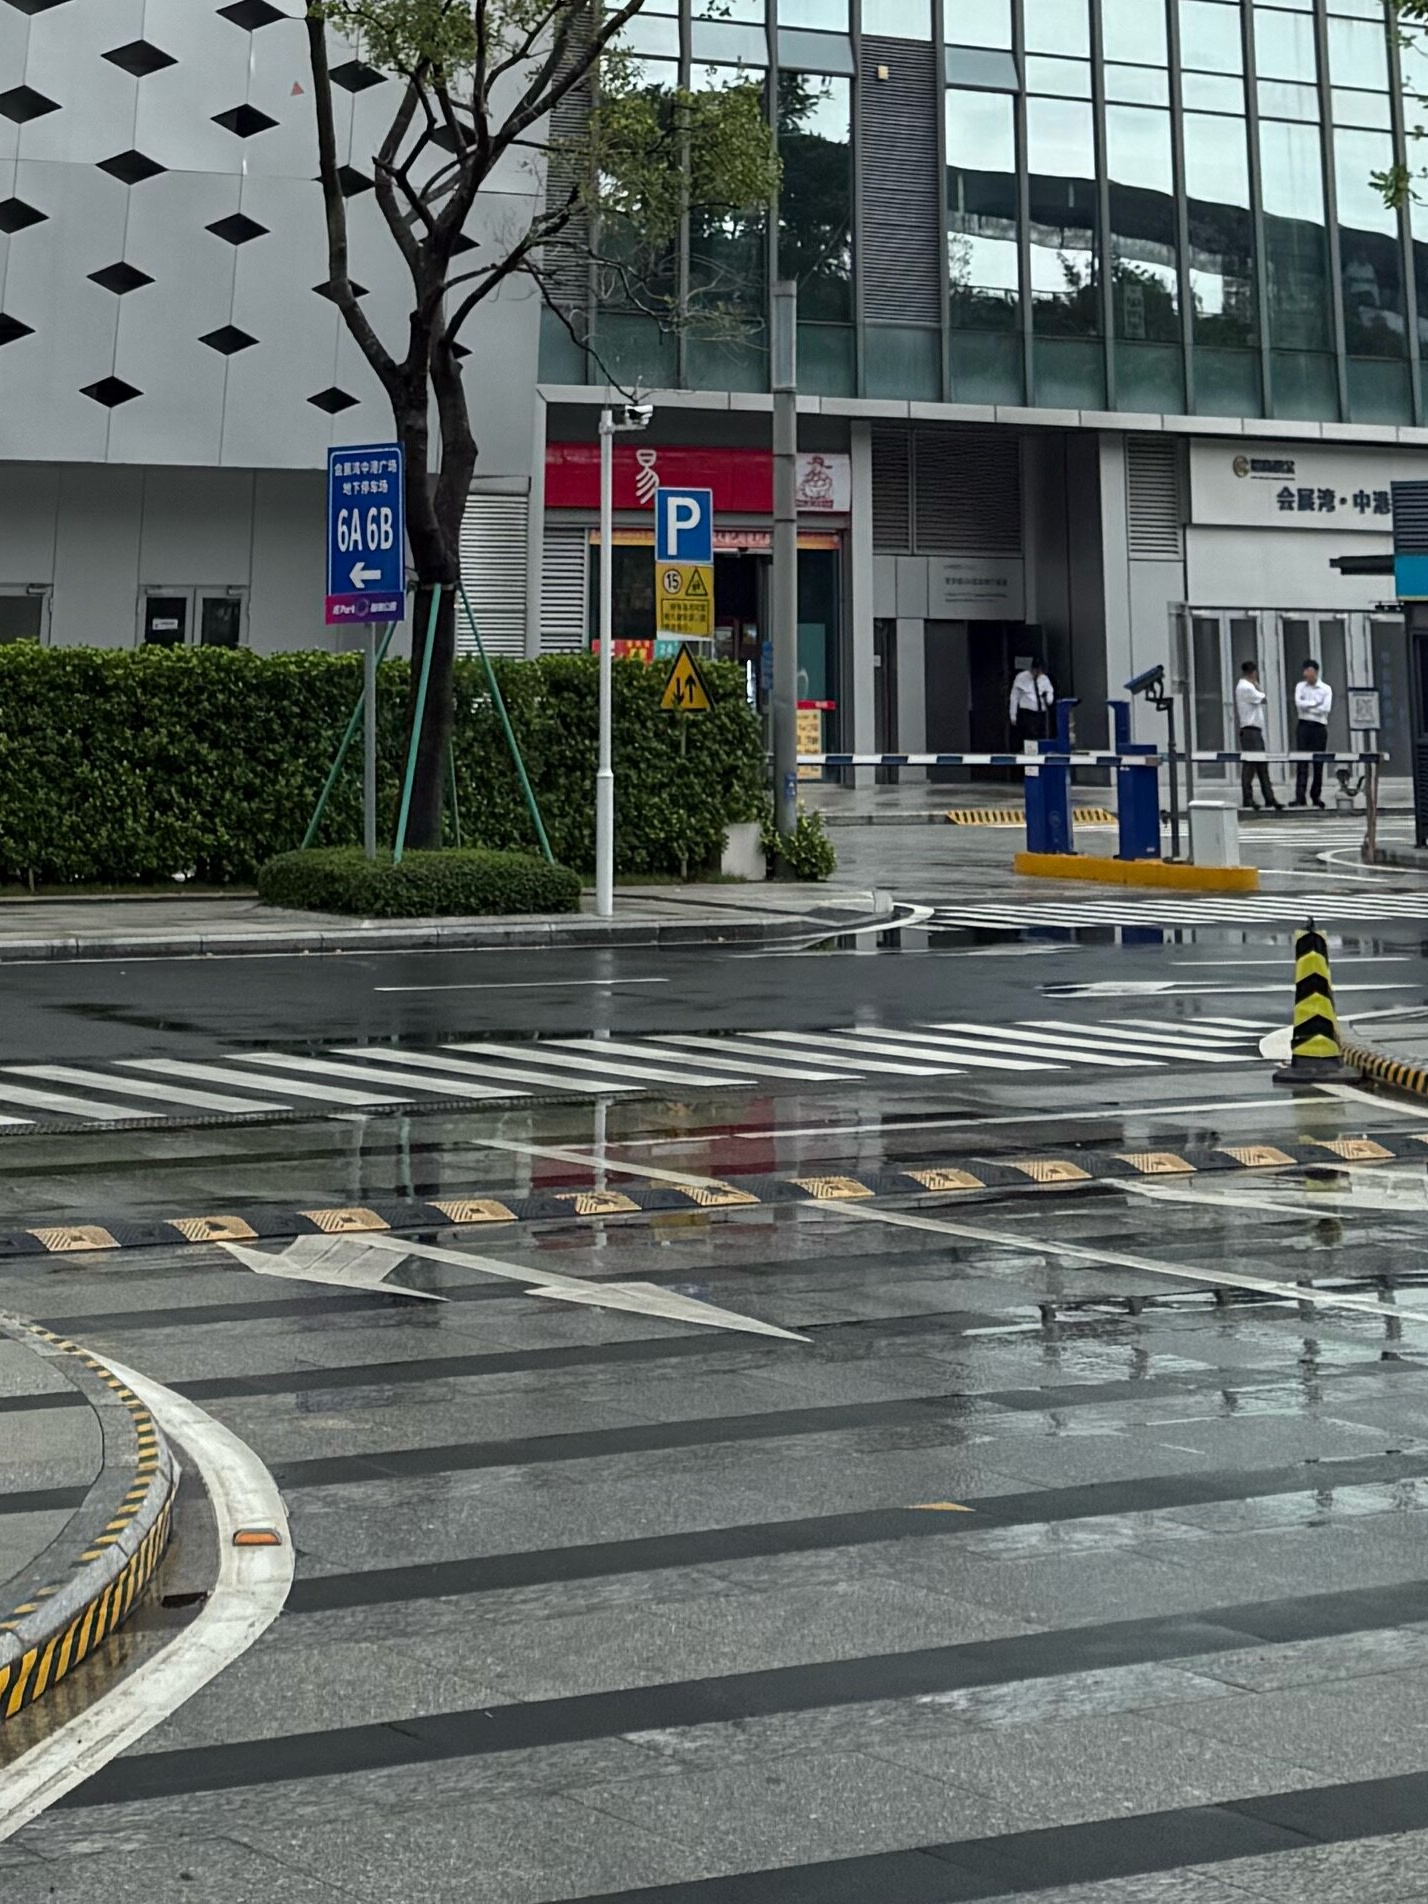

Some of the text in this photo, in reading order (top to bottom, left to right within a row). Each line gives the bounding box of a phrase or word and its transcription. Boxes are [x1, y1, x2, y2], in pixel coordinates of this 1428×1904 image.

[337, 507, 394, 552] 6A 6B
[667, 496, 701, 556] P
[666, 574, 680, 590] 15
